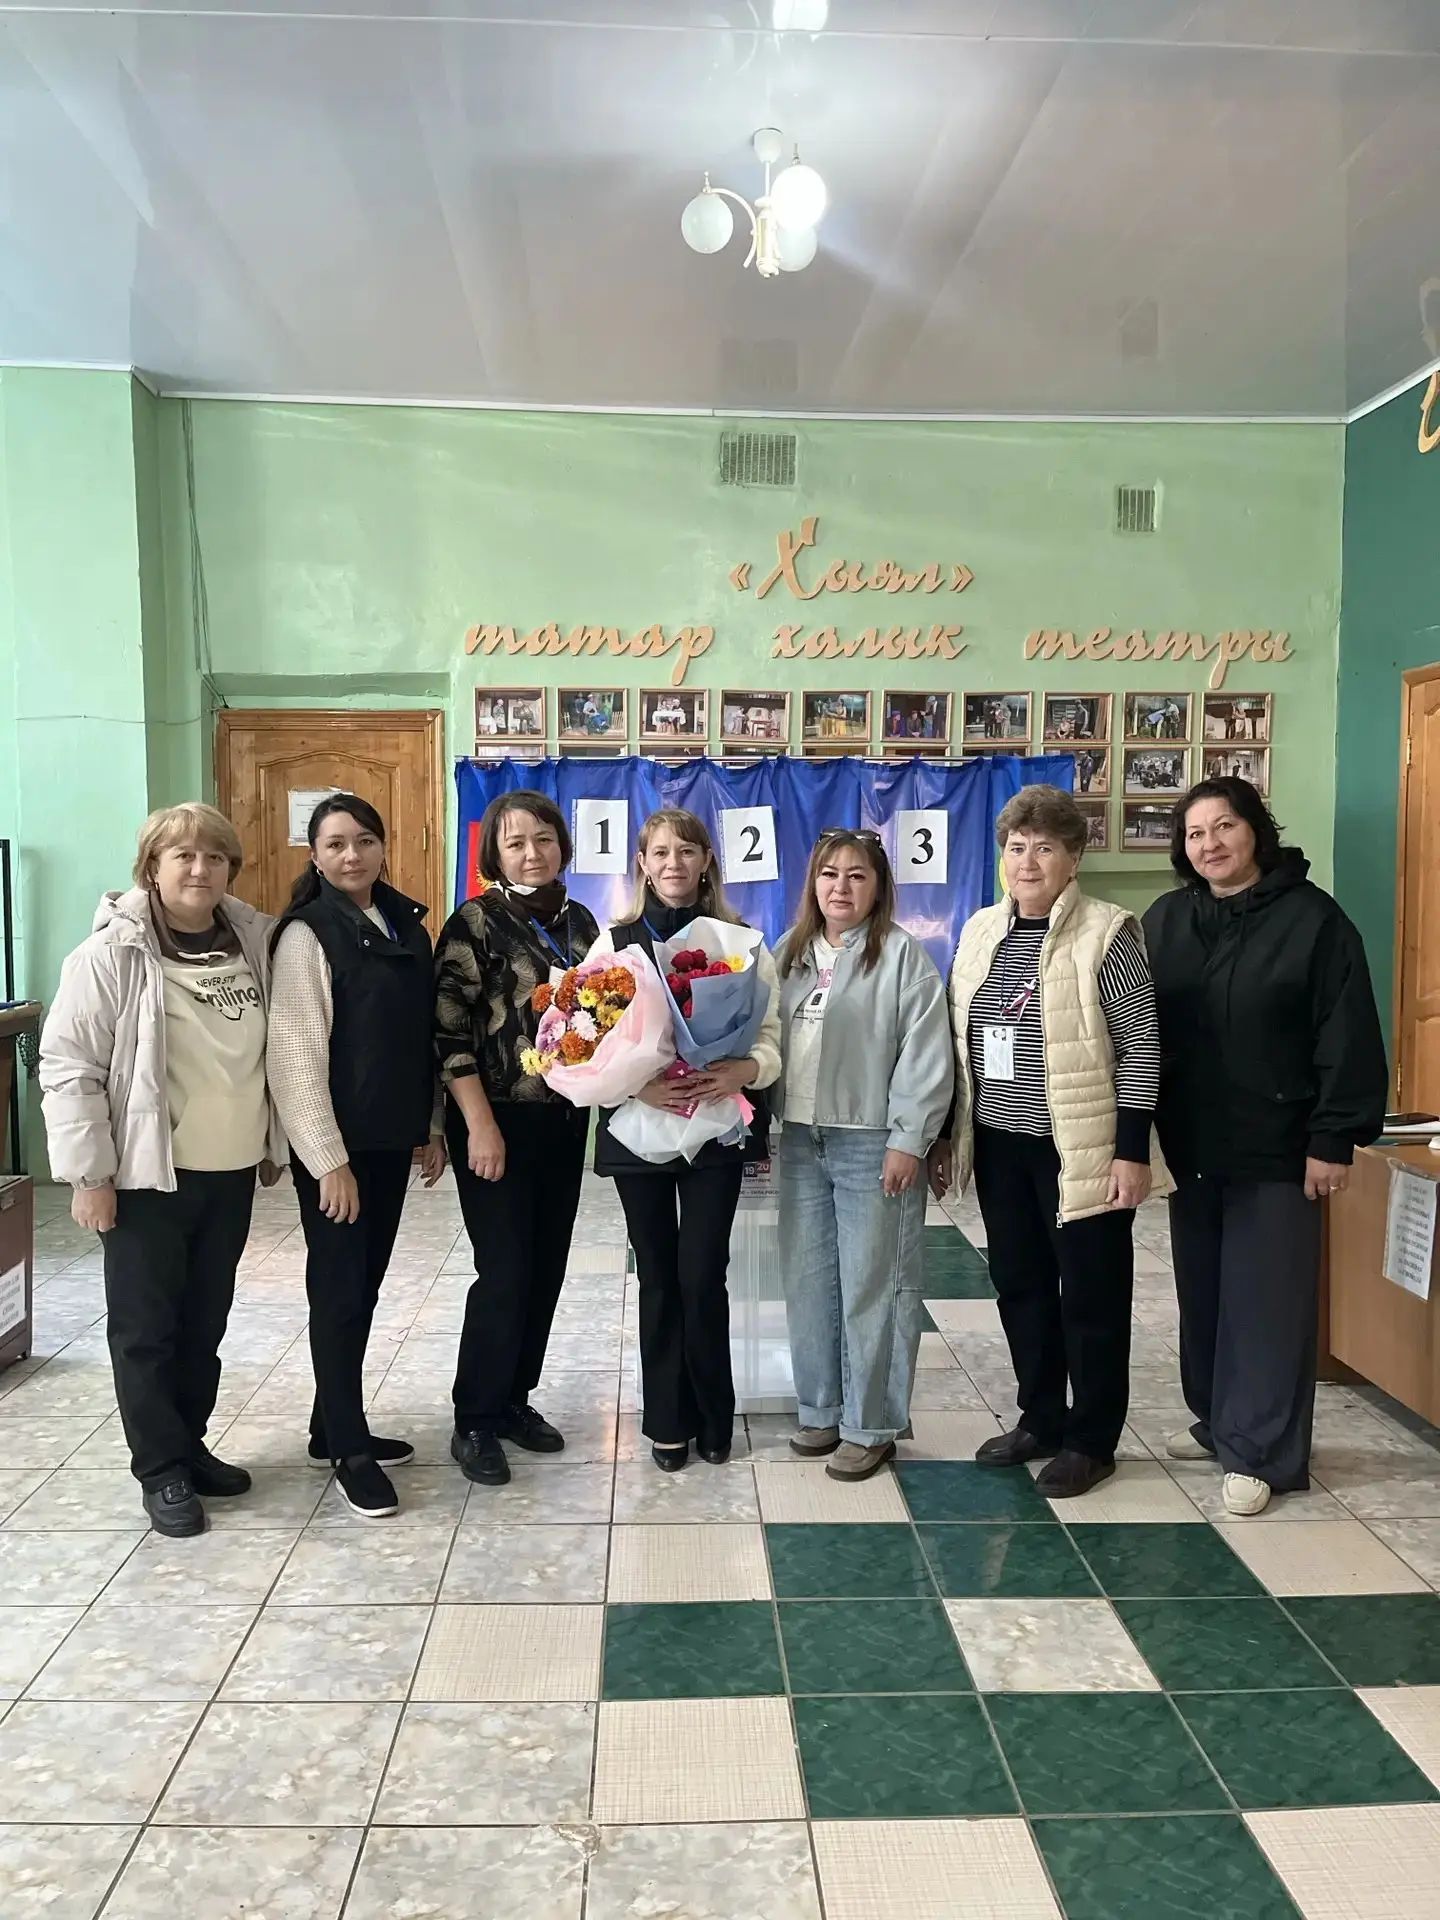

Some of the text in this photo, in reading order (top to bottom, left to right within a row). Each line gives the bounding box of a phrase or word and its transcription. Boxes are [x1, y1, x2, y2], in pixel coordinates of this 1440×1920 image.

[465, 621, 1295, 690] татар халык театры
[594, 818, 613, 854] 1
[739, 825, 764, 862] 2
[911, 828, 935, 865] 3
[196, 977, 221, 988] NEVER
[744, 1162, 770, 1175] 19 20
